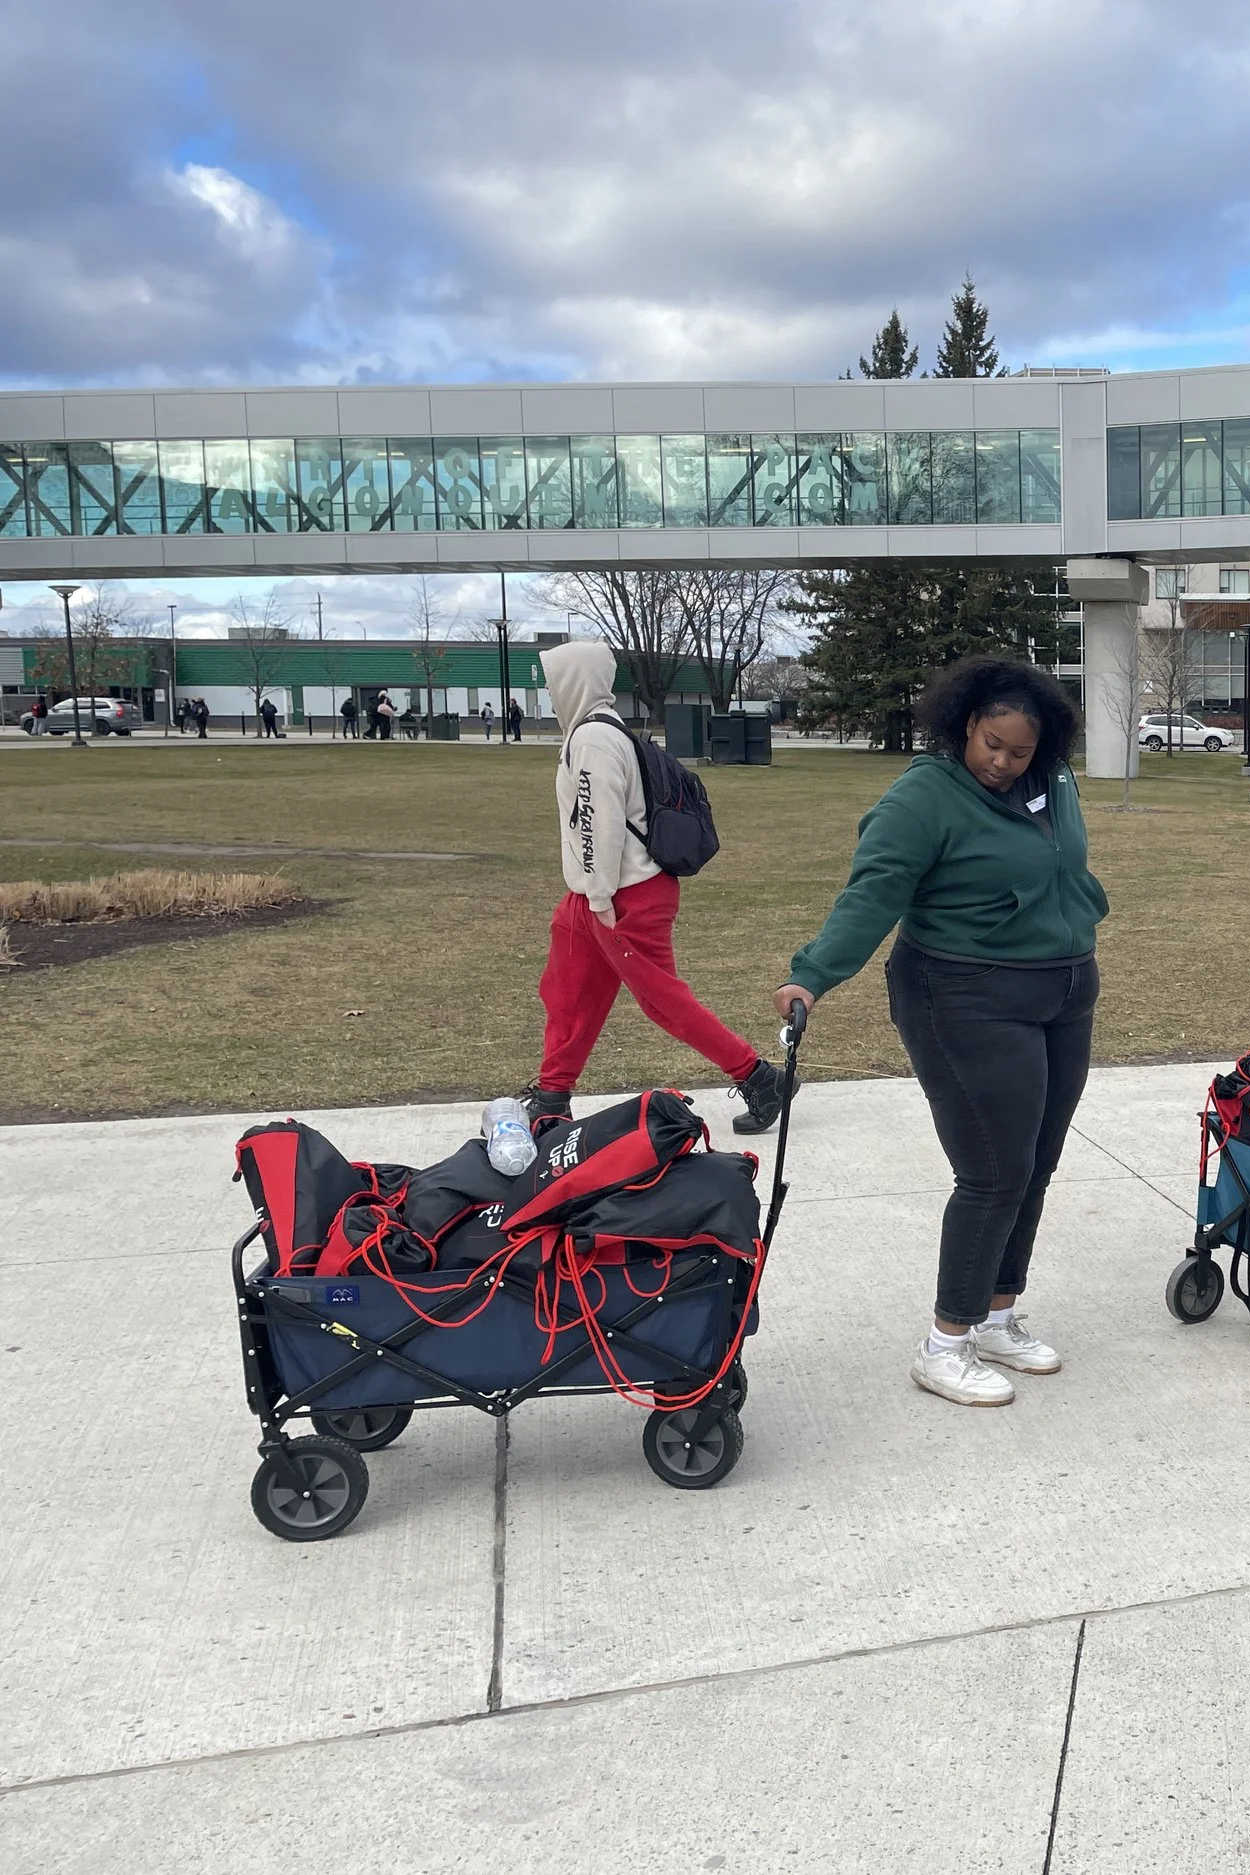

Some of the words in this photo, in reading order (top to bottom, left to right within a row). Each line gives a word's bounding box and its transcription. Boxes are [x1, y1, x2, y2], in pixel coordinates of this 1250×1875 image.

[443, 447, 516, 480] OF
[583, 444, 697, 477] THE
[578, 769, 592, 803] KEEP
[547, 1143, 564, 1167] UP
[563, 1126, 583, 1168] RISE
